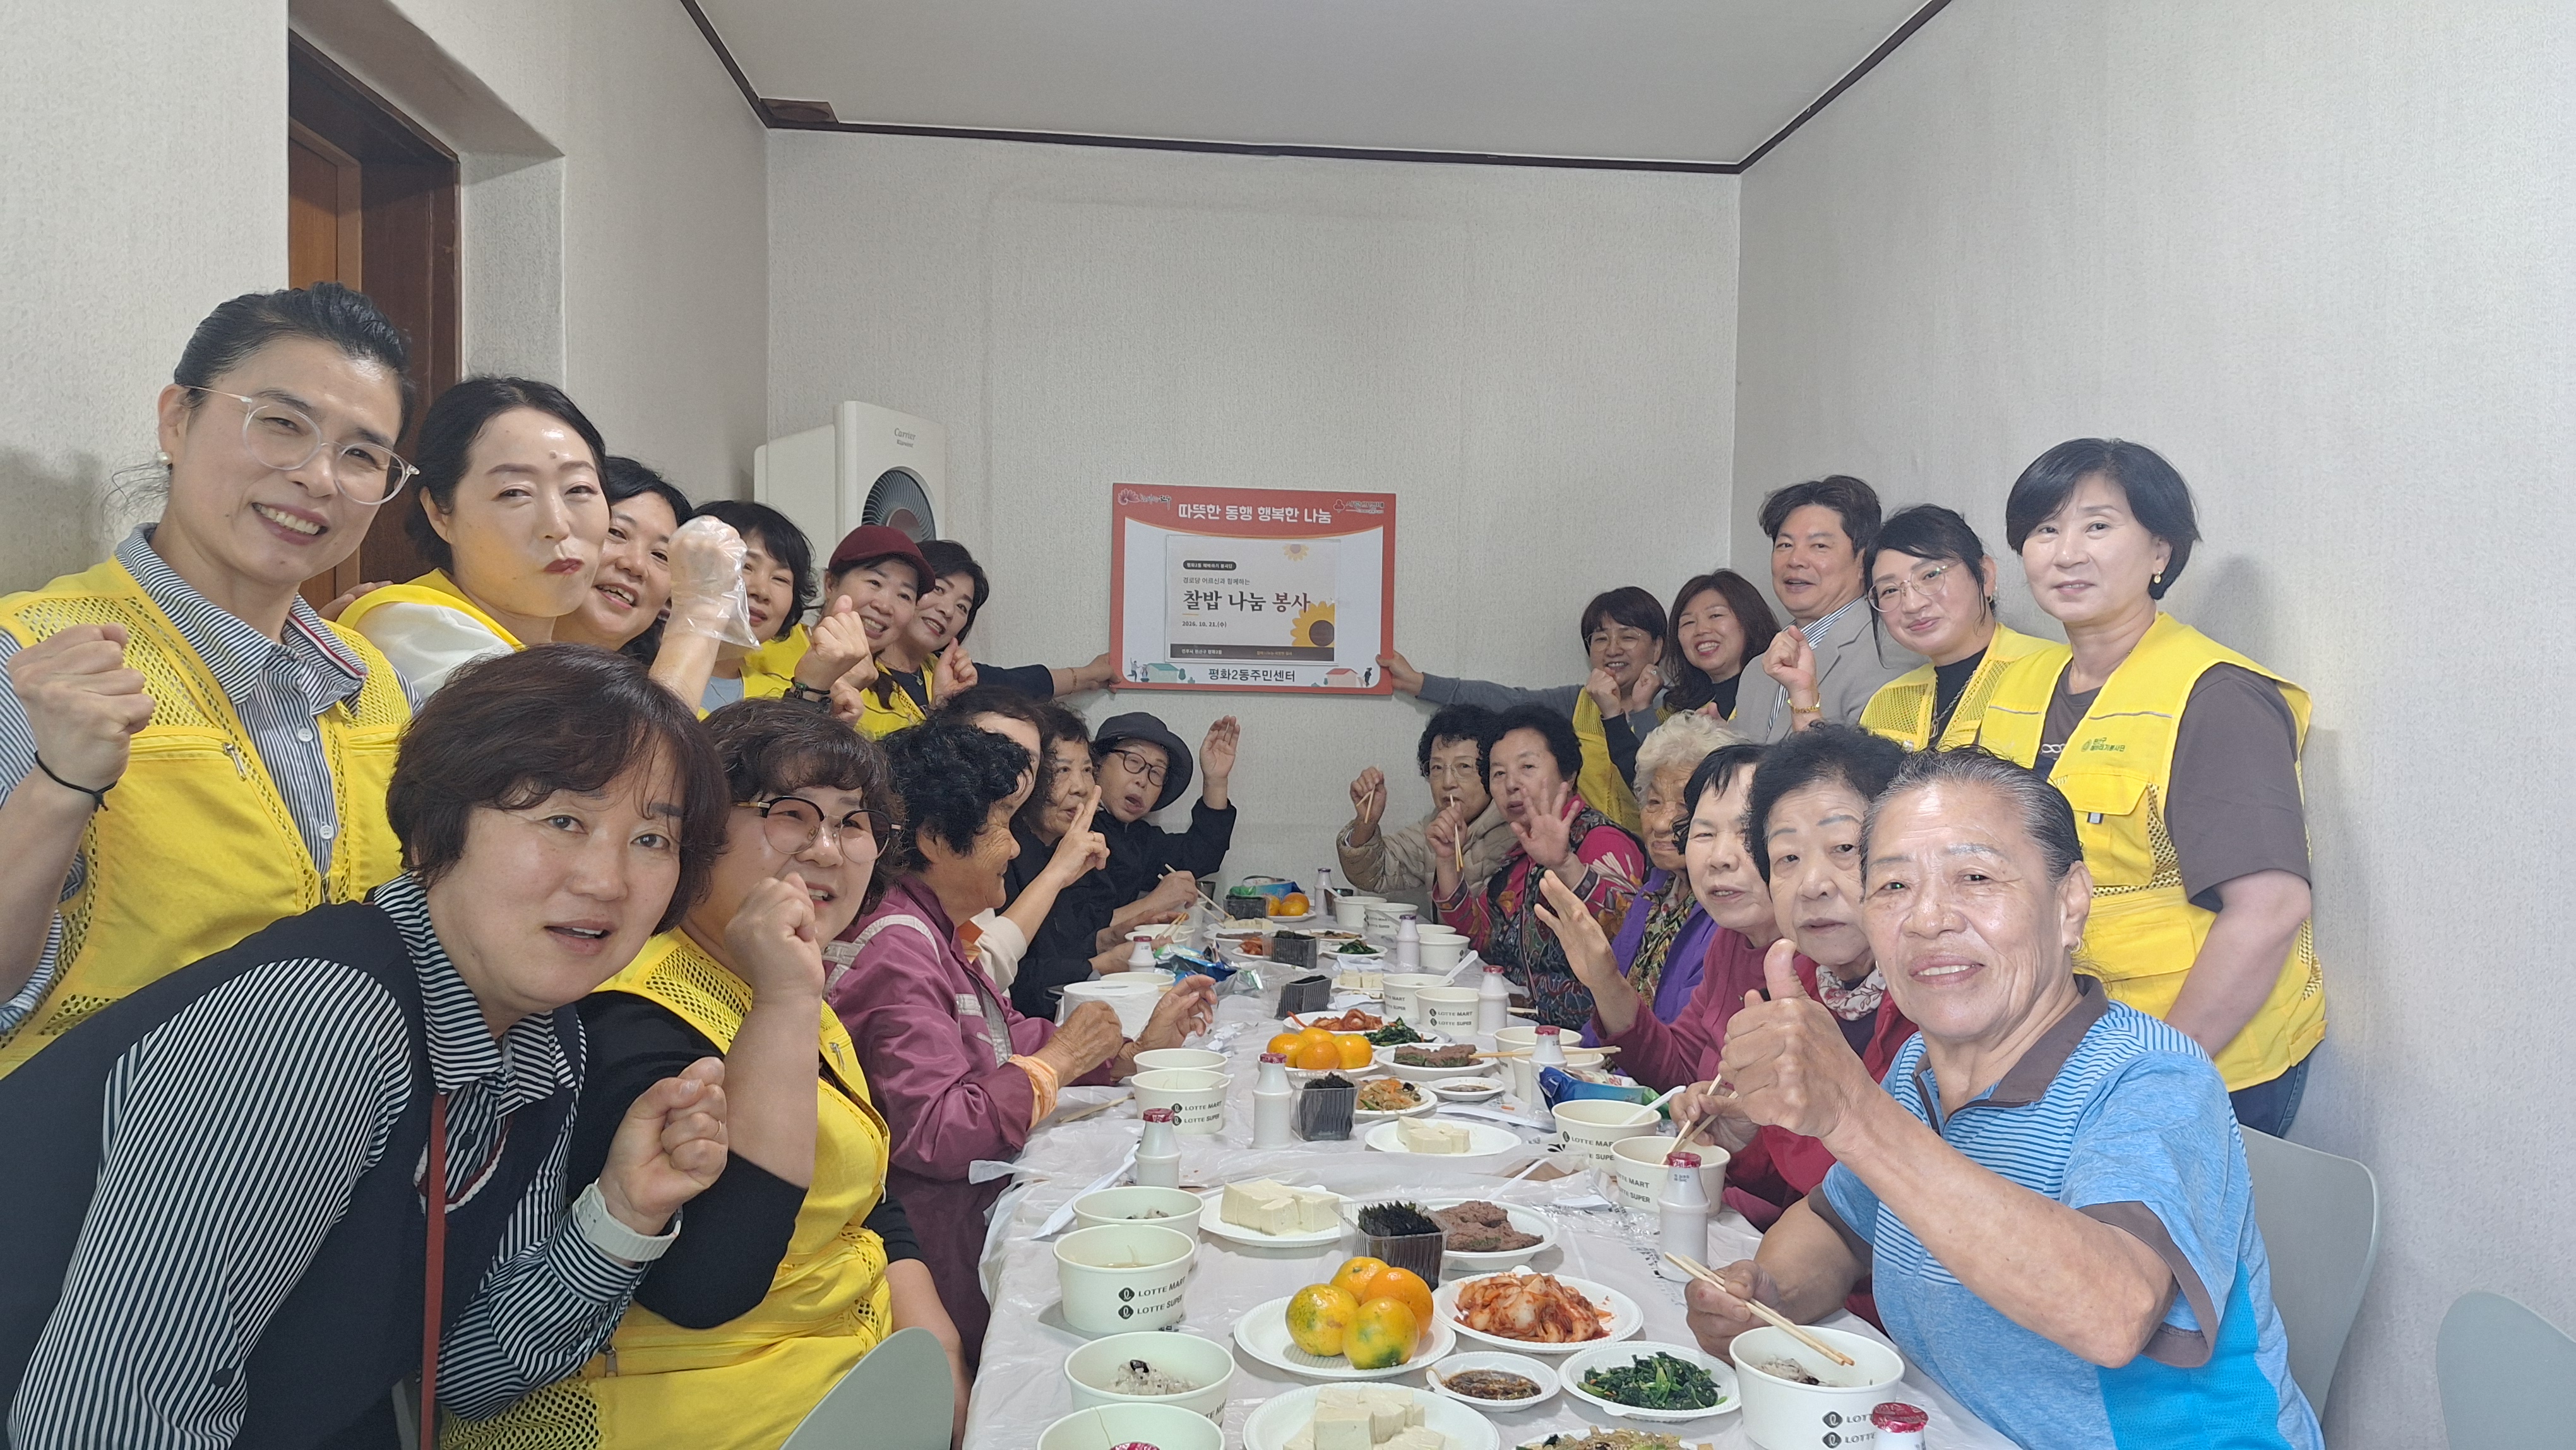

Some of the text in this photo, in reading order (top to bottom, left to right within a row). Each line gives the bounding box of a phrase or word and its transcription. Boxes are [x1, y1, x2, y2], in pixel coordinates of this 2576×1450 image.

[894, 428, 916, 441] Carrier
[1178, 503, 1332, 524] 따뜻한 동행 행복한 나눔
[1183, 589, 1311, 613] 찰밥 나눔 봉사
[1208, 668, 1295, 683] 평화2동주민센터
[1207, 1101, 1222, 1109] MART
[1206, 1113, 1220, 1122] SUPER
[1571, 1137, 1594, 1146] LOTTE
[1629, 1177, 1650, 1189] MART
[1630, 1192, 1650, 1203] SUPER
[1138, 1276, 1186, 1297] LOTTE MART
[1137, 1295, 1183, 1314] LOTTE SUPER
